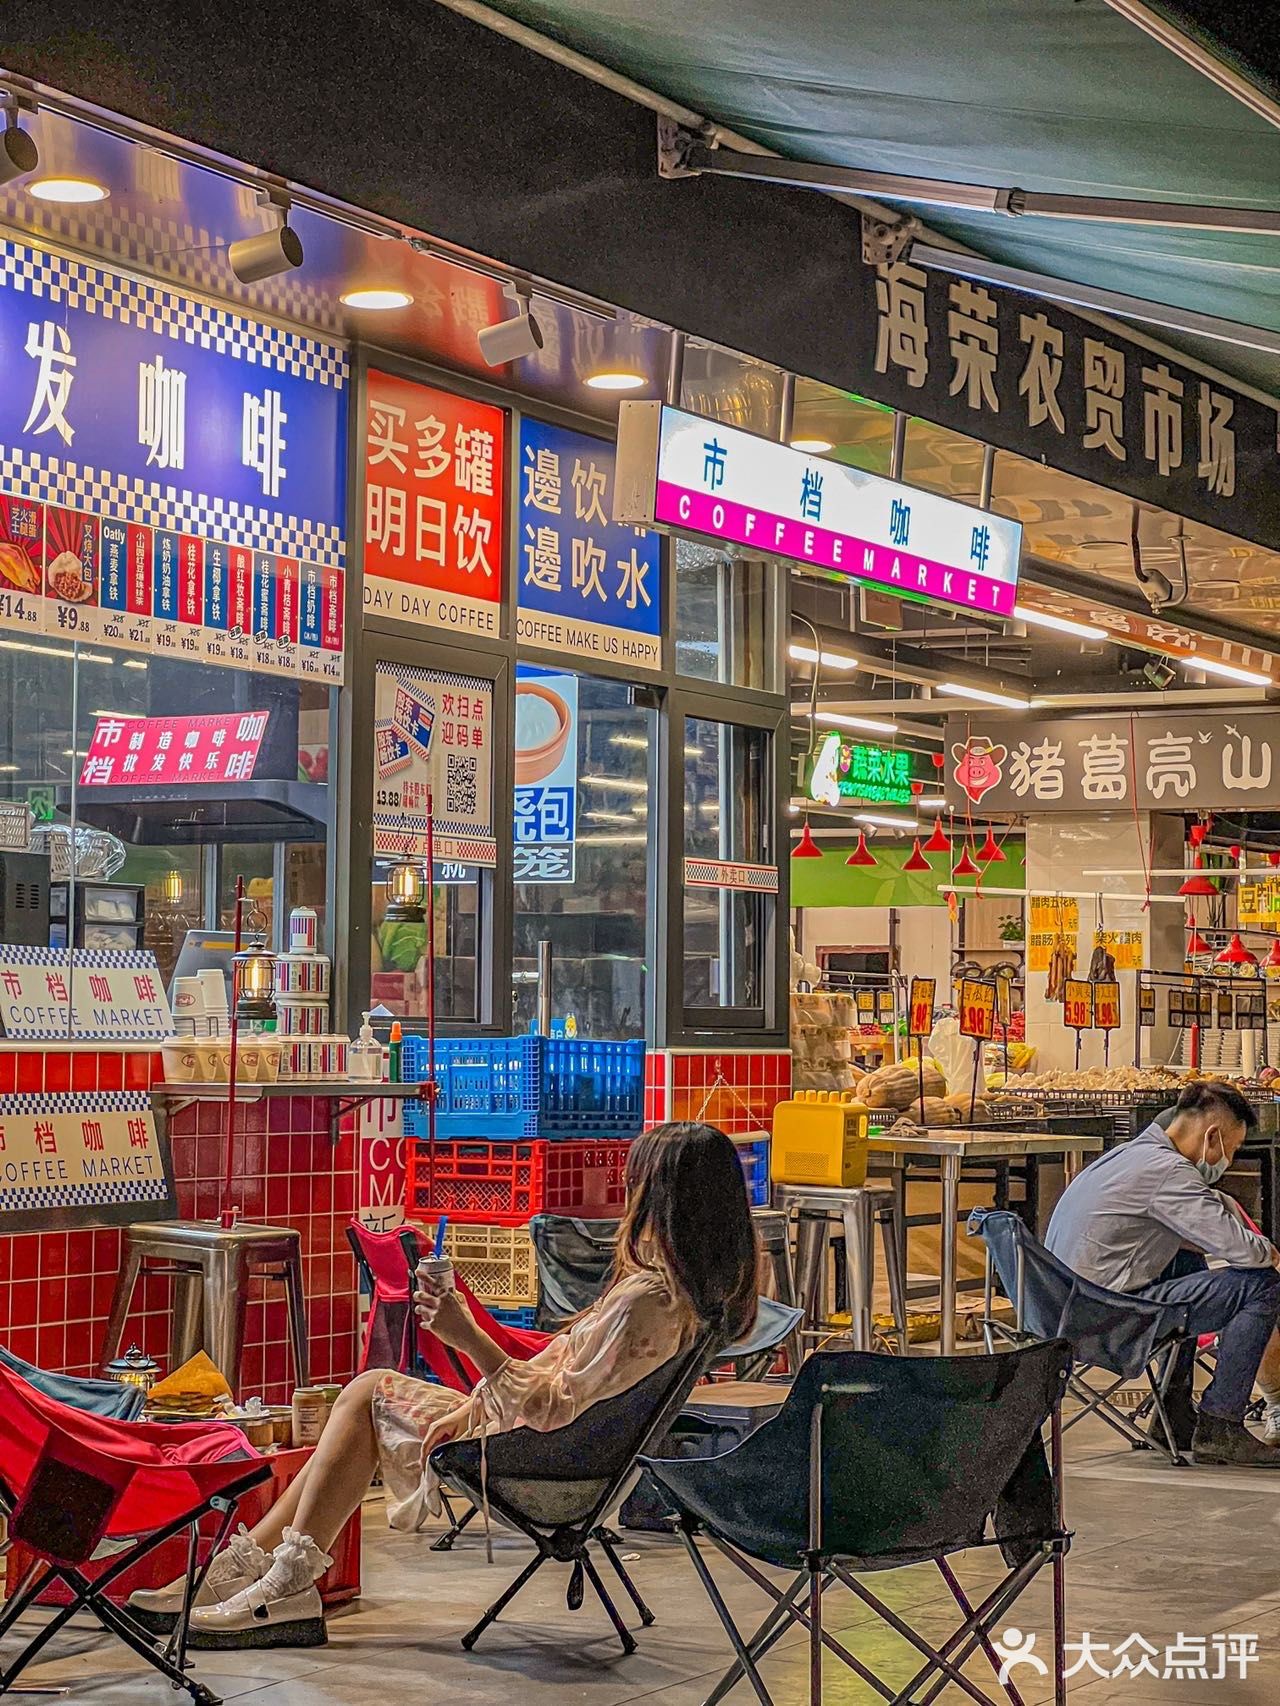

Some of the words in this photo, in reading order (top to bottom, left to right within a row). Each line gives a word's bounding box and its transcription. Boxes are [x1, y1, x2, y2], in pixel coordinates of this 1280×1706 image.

[874, 264, 1236, 497] 海荣农贸市场
[22, 320, 287, 497] 发咖啡
[367, 400, 494, 496] 买多罐
[703, 437, 990, 571] 市档咖啡
[103, 525, 126, 545] Oatly
[366, 483, 493, 577] 明日饮
[109, 543, 119, 601] 燕麦拿铁
[187, 543, 196, 616] 桂花拿铁
[212, 549, 221, 621] 生椰拿铁
[524, 523, 651, 610] 邊吹水
[58, 605, 90, 633] ¥9.88
[363, 586, 394, 610] DAY
[401, 595, 431, 617] DAY
[438, 603, 494, 631] COFFEE
[516, 618, 562, 643] COFFEE
[566, 628, 599, 651] MAKE
[603, 636, 618, 654] US
[622, 639, 658, 662] HAPPY
[128, 728, 226, 750] 制造咖啡
[122, 751, 220, 773] 批发快乐
[721, 868, 745, 885] 外卖口
[1, 970, 157, 1003] 市档咖啡
[10, 1005, 82, 1026] COFFEE
[93, 1008, 164, 1026] MARKET
[82, 1155, 153, 1178] MARKET
